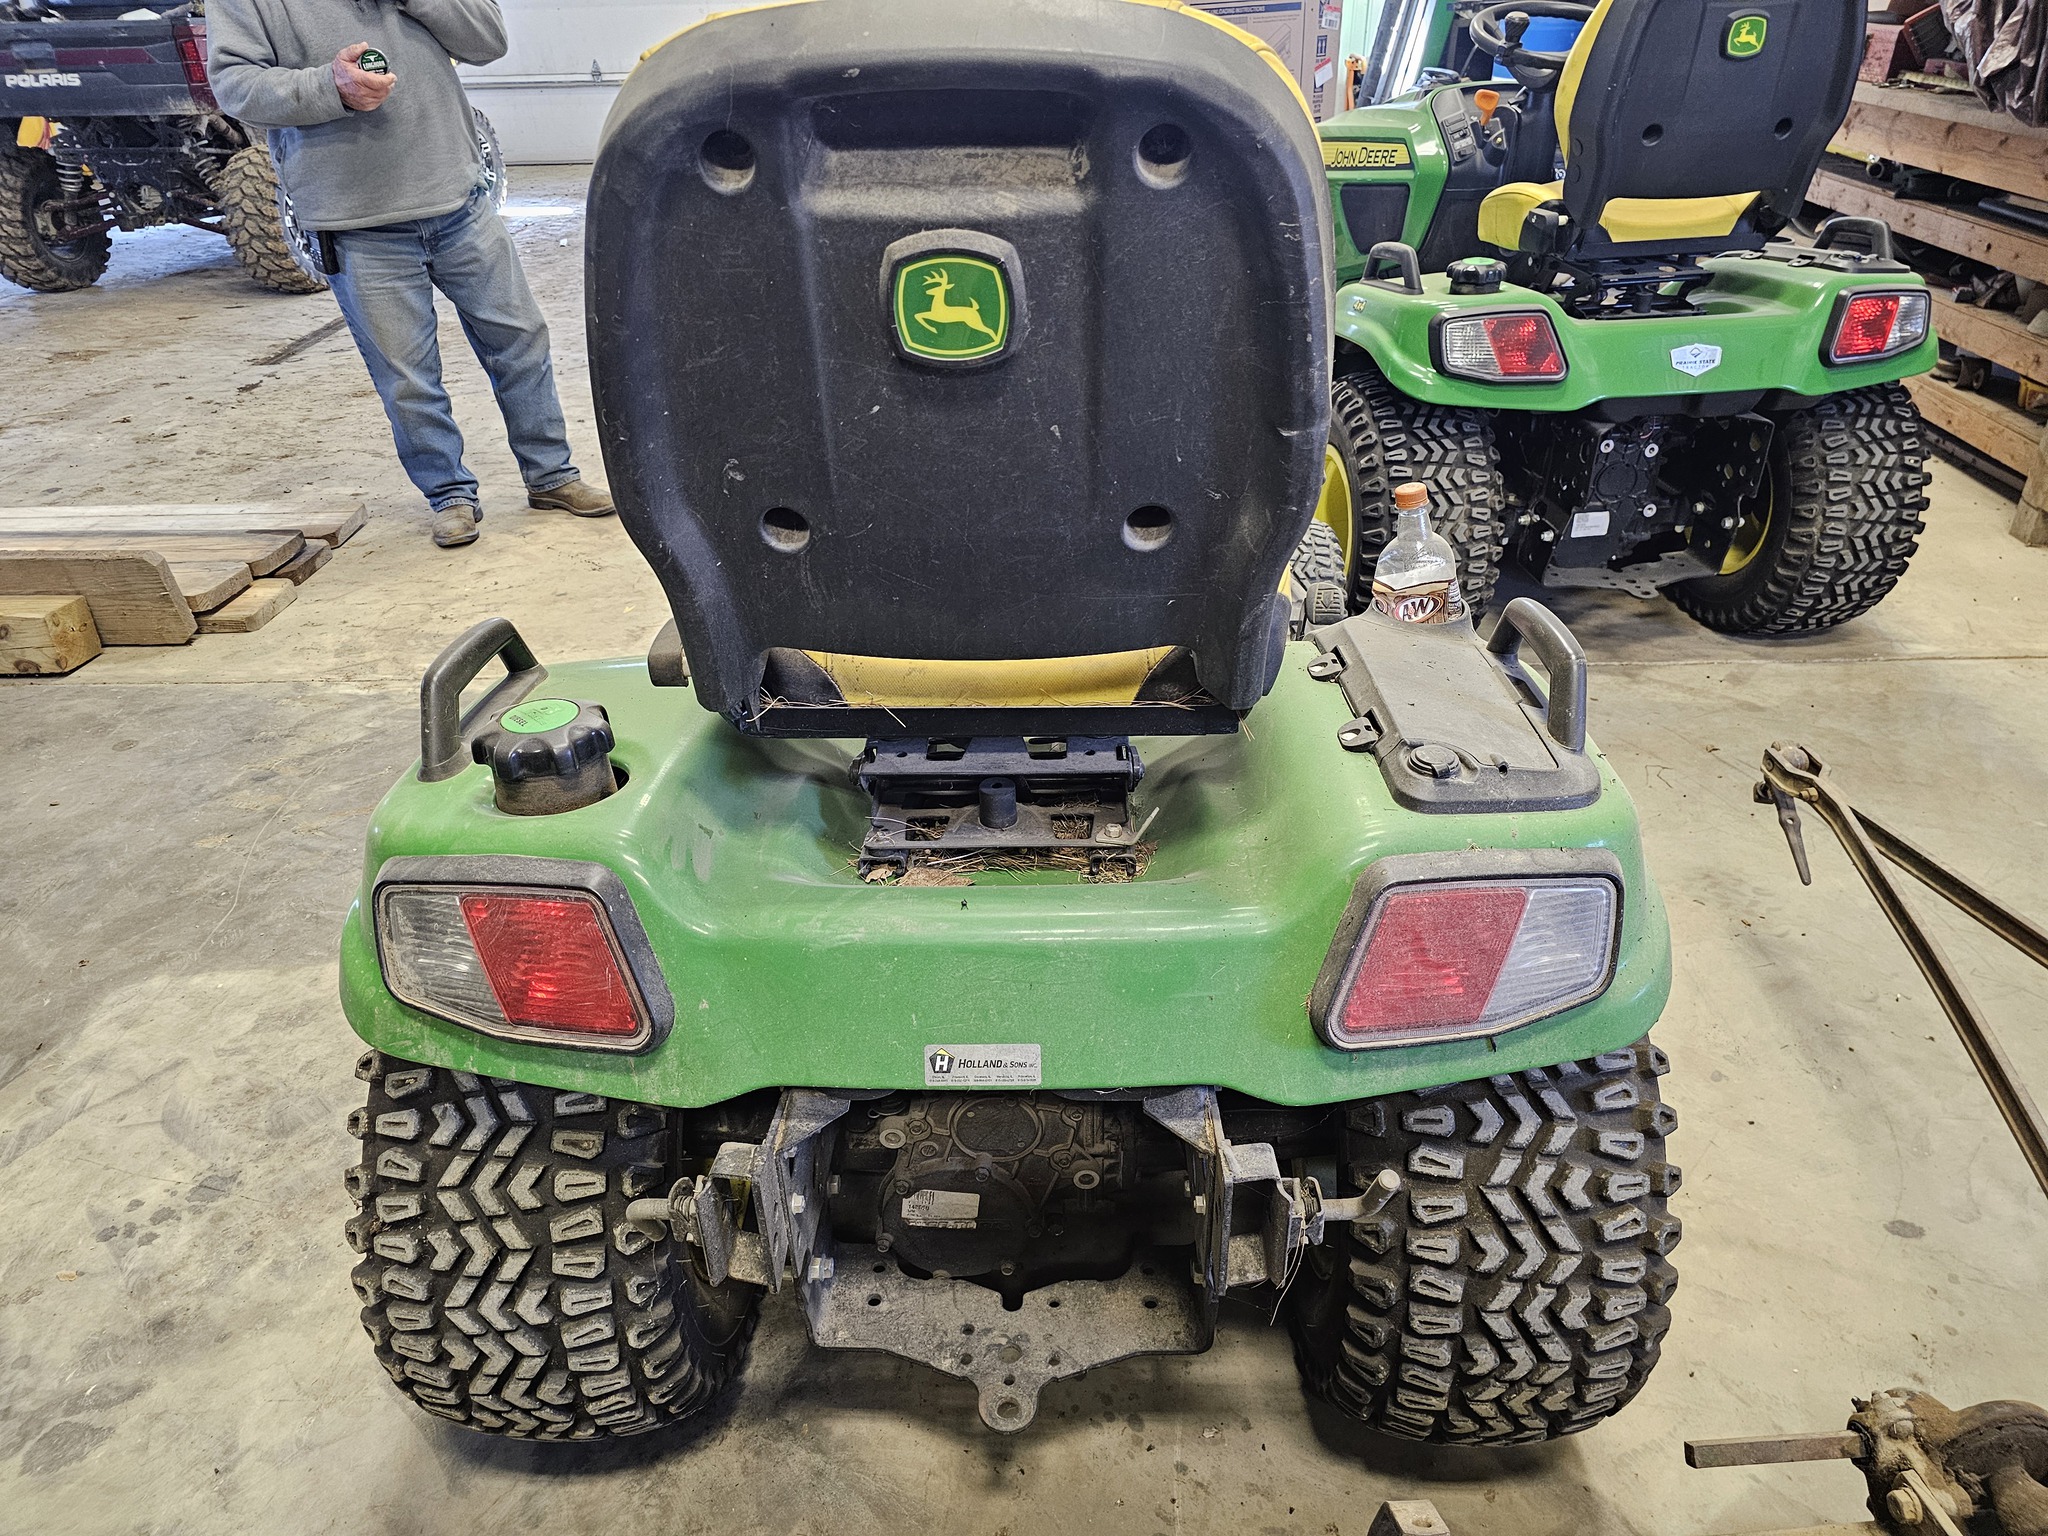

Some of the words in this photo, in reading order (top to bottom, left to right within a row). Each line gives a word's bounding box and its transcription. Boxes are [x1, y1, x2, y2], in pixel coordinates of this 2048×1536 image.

[5, 73, 81, 88] POLARIS
[1331, 147, 1358, 165] JOHN
[1358, 146, 1398, 165] DEERE
[1403, 596, 1431, 621] A&W
[509, 715, 528, 727] DIESEL
[958, 1058, 1003, 1069] HOLLAND
[1009, 1060, 1028, 1069] SONS
